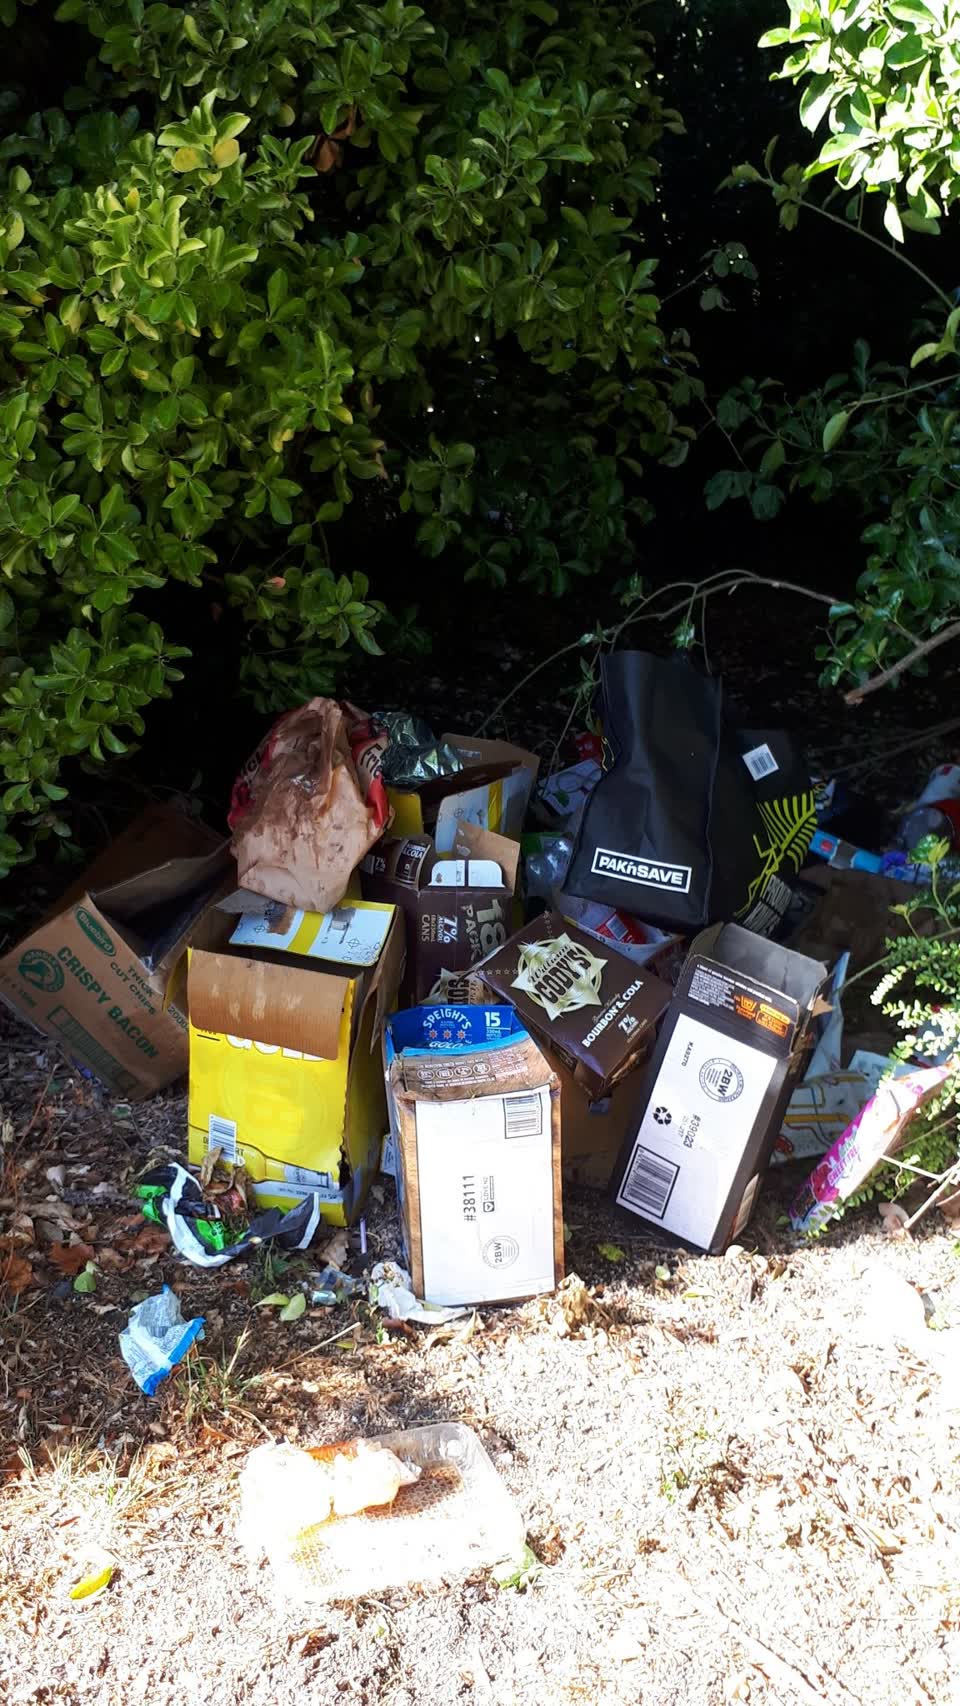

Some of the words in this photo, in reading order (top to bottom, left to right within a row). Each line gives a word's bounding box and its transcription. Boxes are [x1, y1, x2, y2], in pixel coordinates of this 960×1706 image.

[79, 912, 112, 952] Bluebird
[421, 914, 431, 943] CANS
[443, 914, 458, 944] 7%
[461, 904, 483, 961] PACK
[110, 961, 131, 983] CUT
[129, 984, 157, 1016] CHIPS
[127, 966, 155, 998] THICK
[534, 948, 592, 1004] CODY'S
[57, 946, 112, 1004] CRISPY
[108, 1005, 159, 1059] BACON
[422, 1008, 472, 1030] SPEIGHT'S
[484, 1011, 501, 1028] 15
[581, 1008, 618, 1049] BOURBON
[614, 1000, 626, 1013] &
[622, 980, 645, 1004] COLA
[618, 1014, 636, 1034] 7%
[716, 1068, 733, 1096] 2BW
[683, 1113, 702, 1149] #39023
[462, 1174, 477, 1222] #38111
[493, 1241, 503, 1264] 2BW
